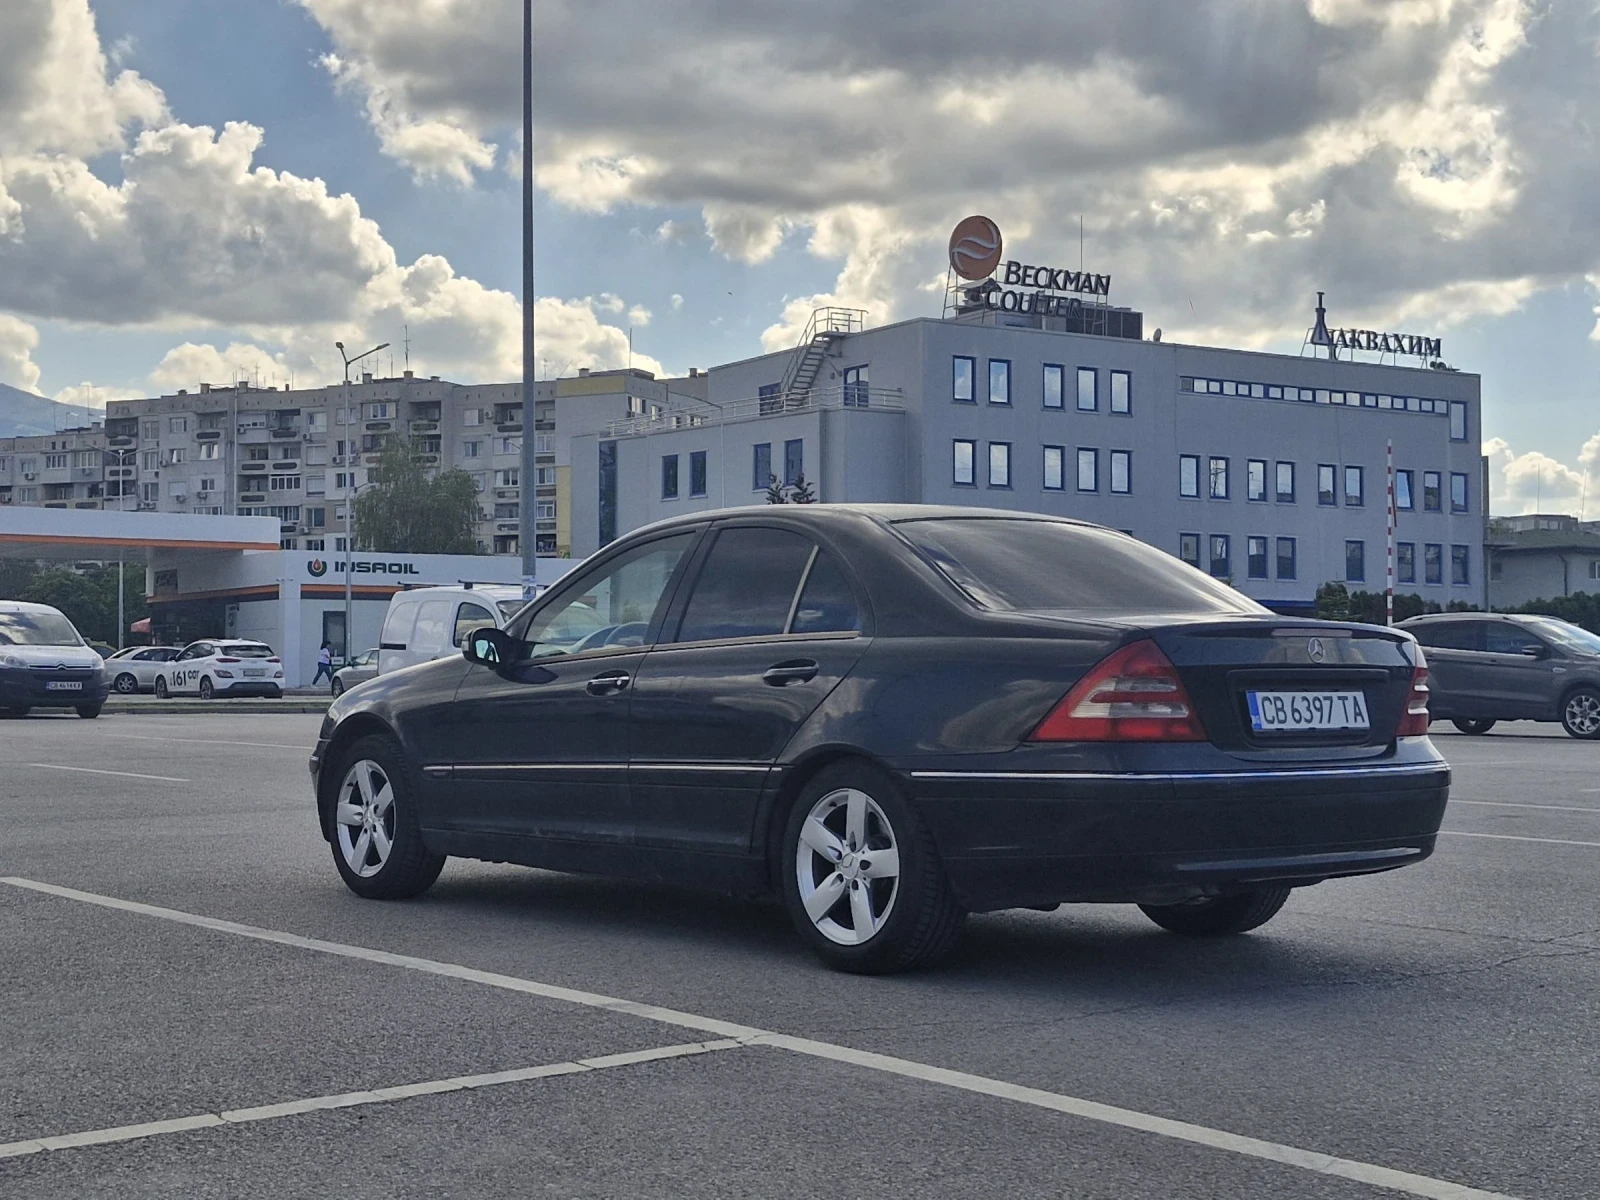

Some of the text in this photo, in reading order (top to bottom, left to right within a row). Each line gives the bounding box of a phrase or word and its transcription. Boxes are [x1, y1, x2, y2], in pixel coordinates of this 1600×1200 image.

[1004, 260, 1111, 296] BECKMAN
[984, 286, 1083, 319] COULTER
[334, 560, 420, 575] INSAOIL
[1261, 696, 1366, 725] CB 6397 TA
